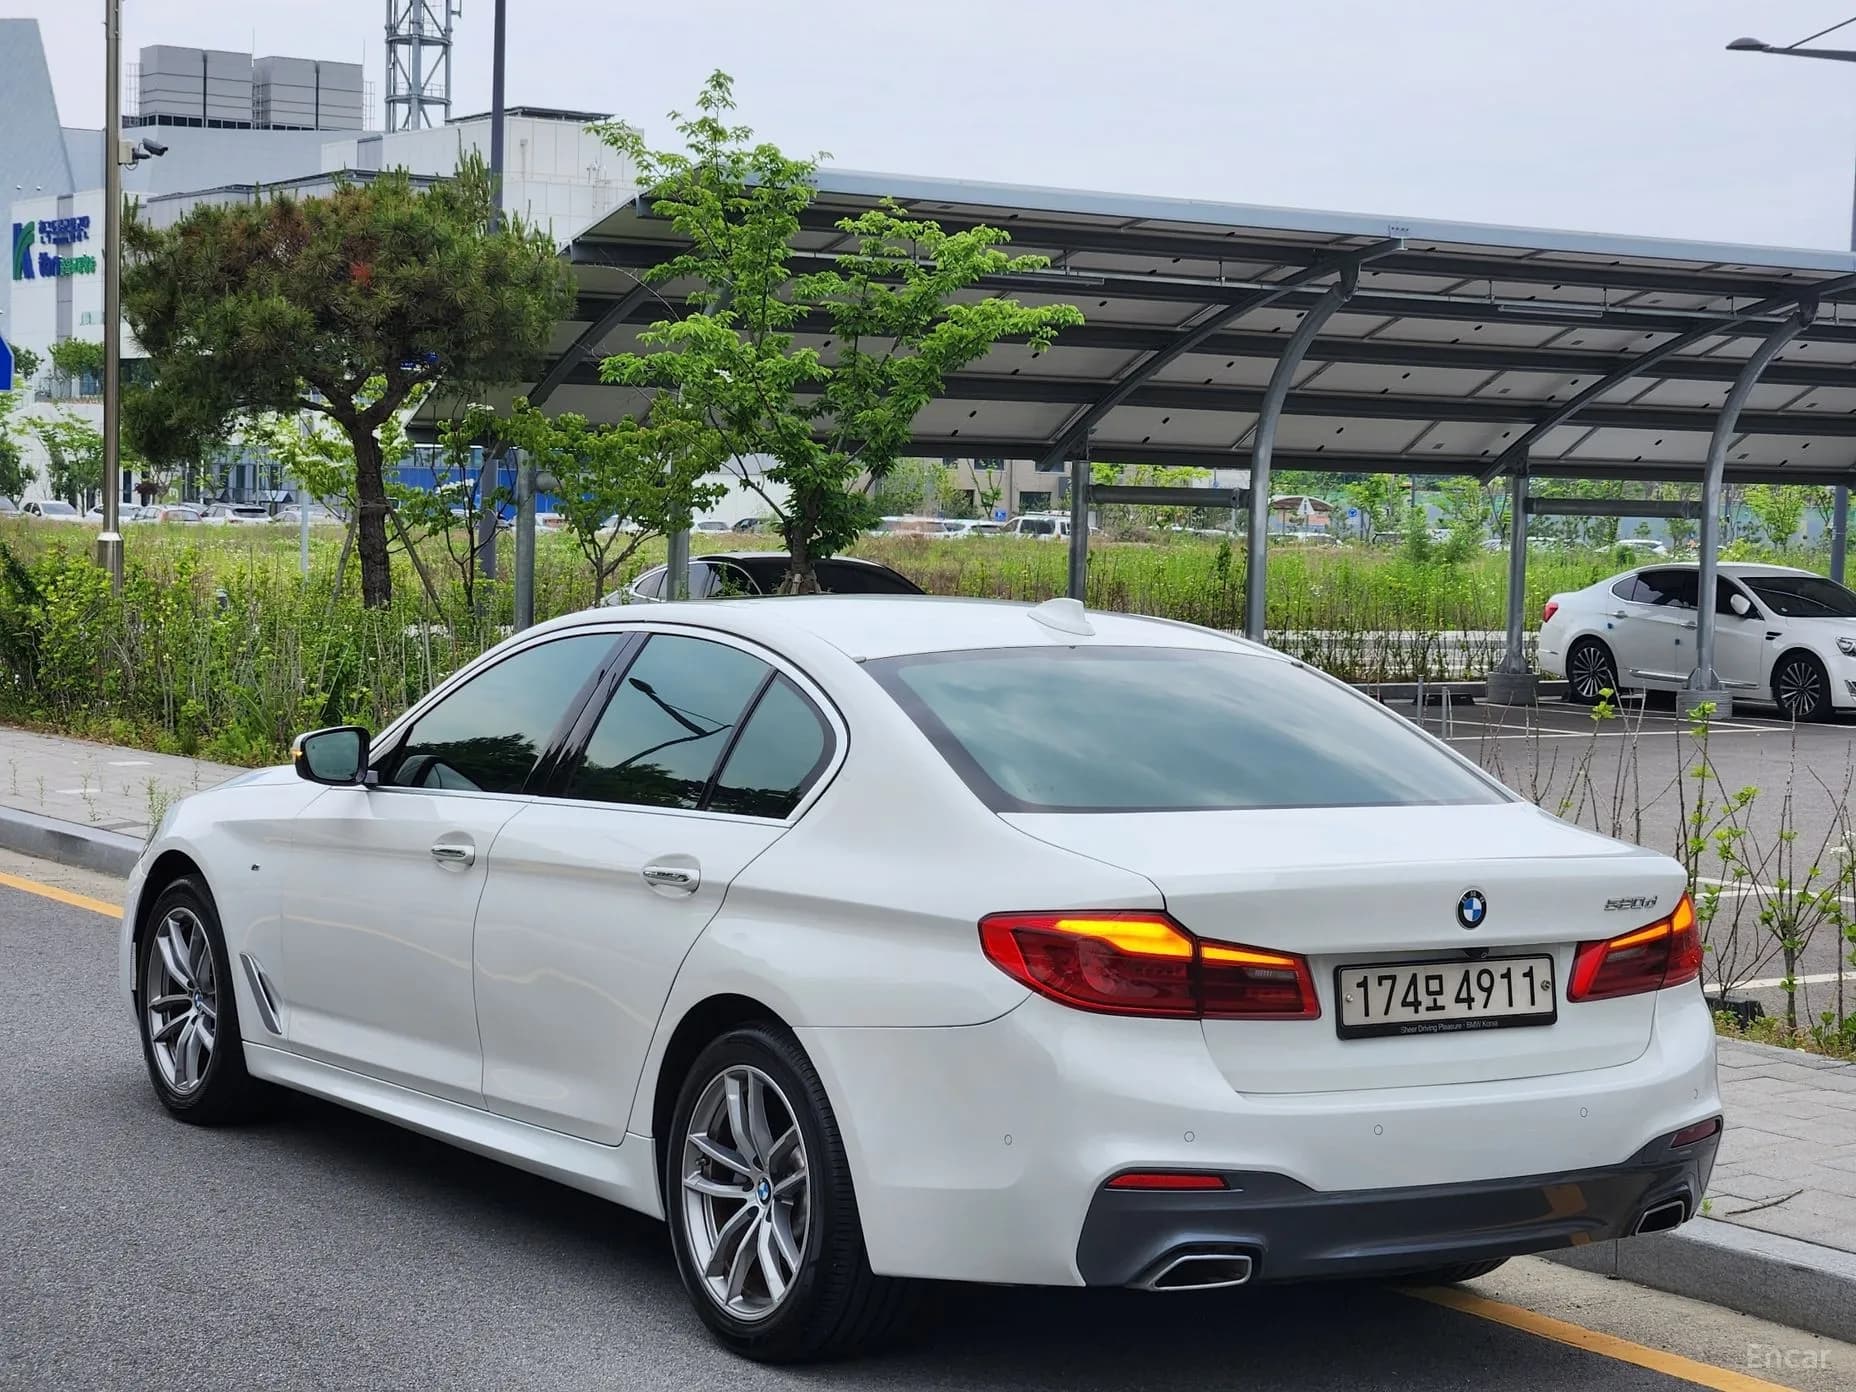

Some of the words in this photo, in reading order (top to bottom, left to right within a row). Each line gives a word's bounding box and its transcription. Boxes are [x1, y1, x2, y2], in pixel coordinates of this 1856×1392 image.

[1356, 972, 1446, 1017] 174모
[1454, 965, 1536, 1010] 4911
[1400, 1025, 1417, 1034] Sheer
[1418, 1024, 1437, 1033] Driving
[1438, 1022, 1462, 1031] Pleasure
[1466, 1020, 1481, 1029] BMW
[1482, 1019, 1498, 1028] Korea
